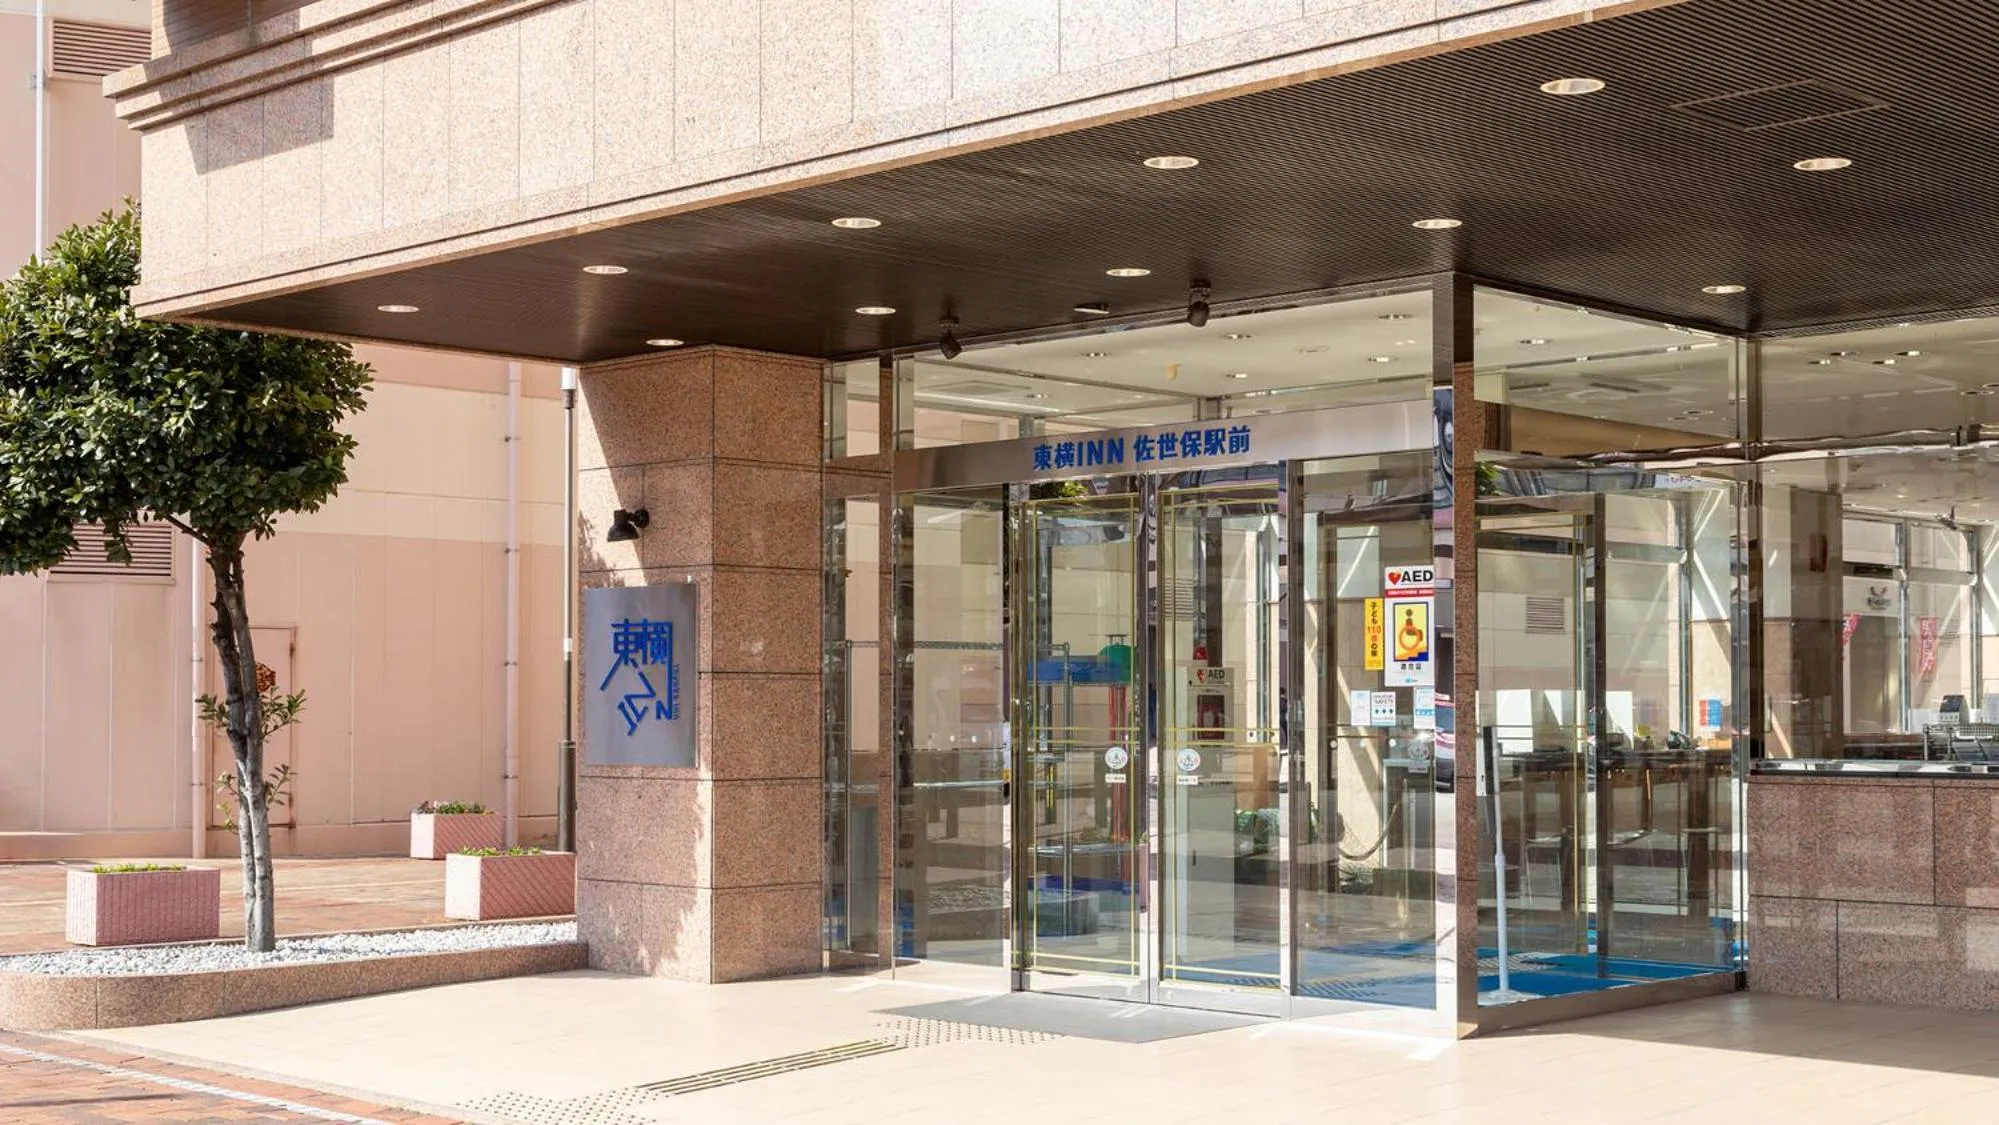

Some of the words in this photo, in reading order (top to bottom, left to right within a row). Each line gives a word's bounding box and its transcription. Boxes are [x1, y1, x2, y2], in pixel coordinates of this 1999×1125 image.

[1032, 435, 1124, 471] 東横INN
[1133, 425, 1251, 463] 佐世保駅前
[1401, 569, 1433, 582] AED
[1208, 669, 1225, 679] AED
